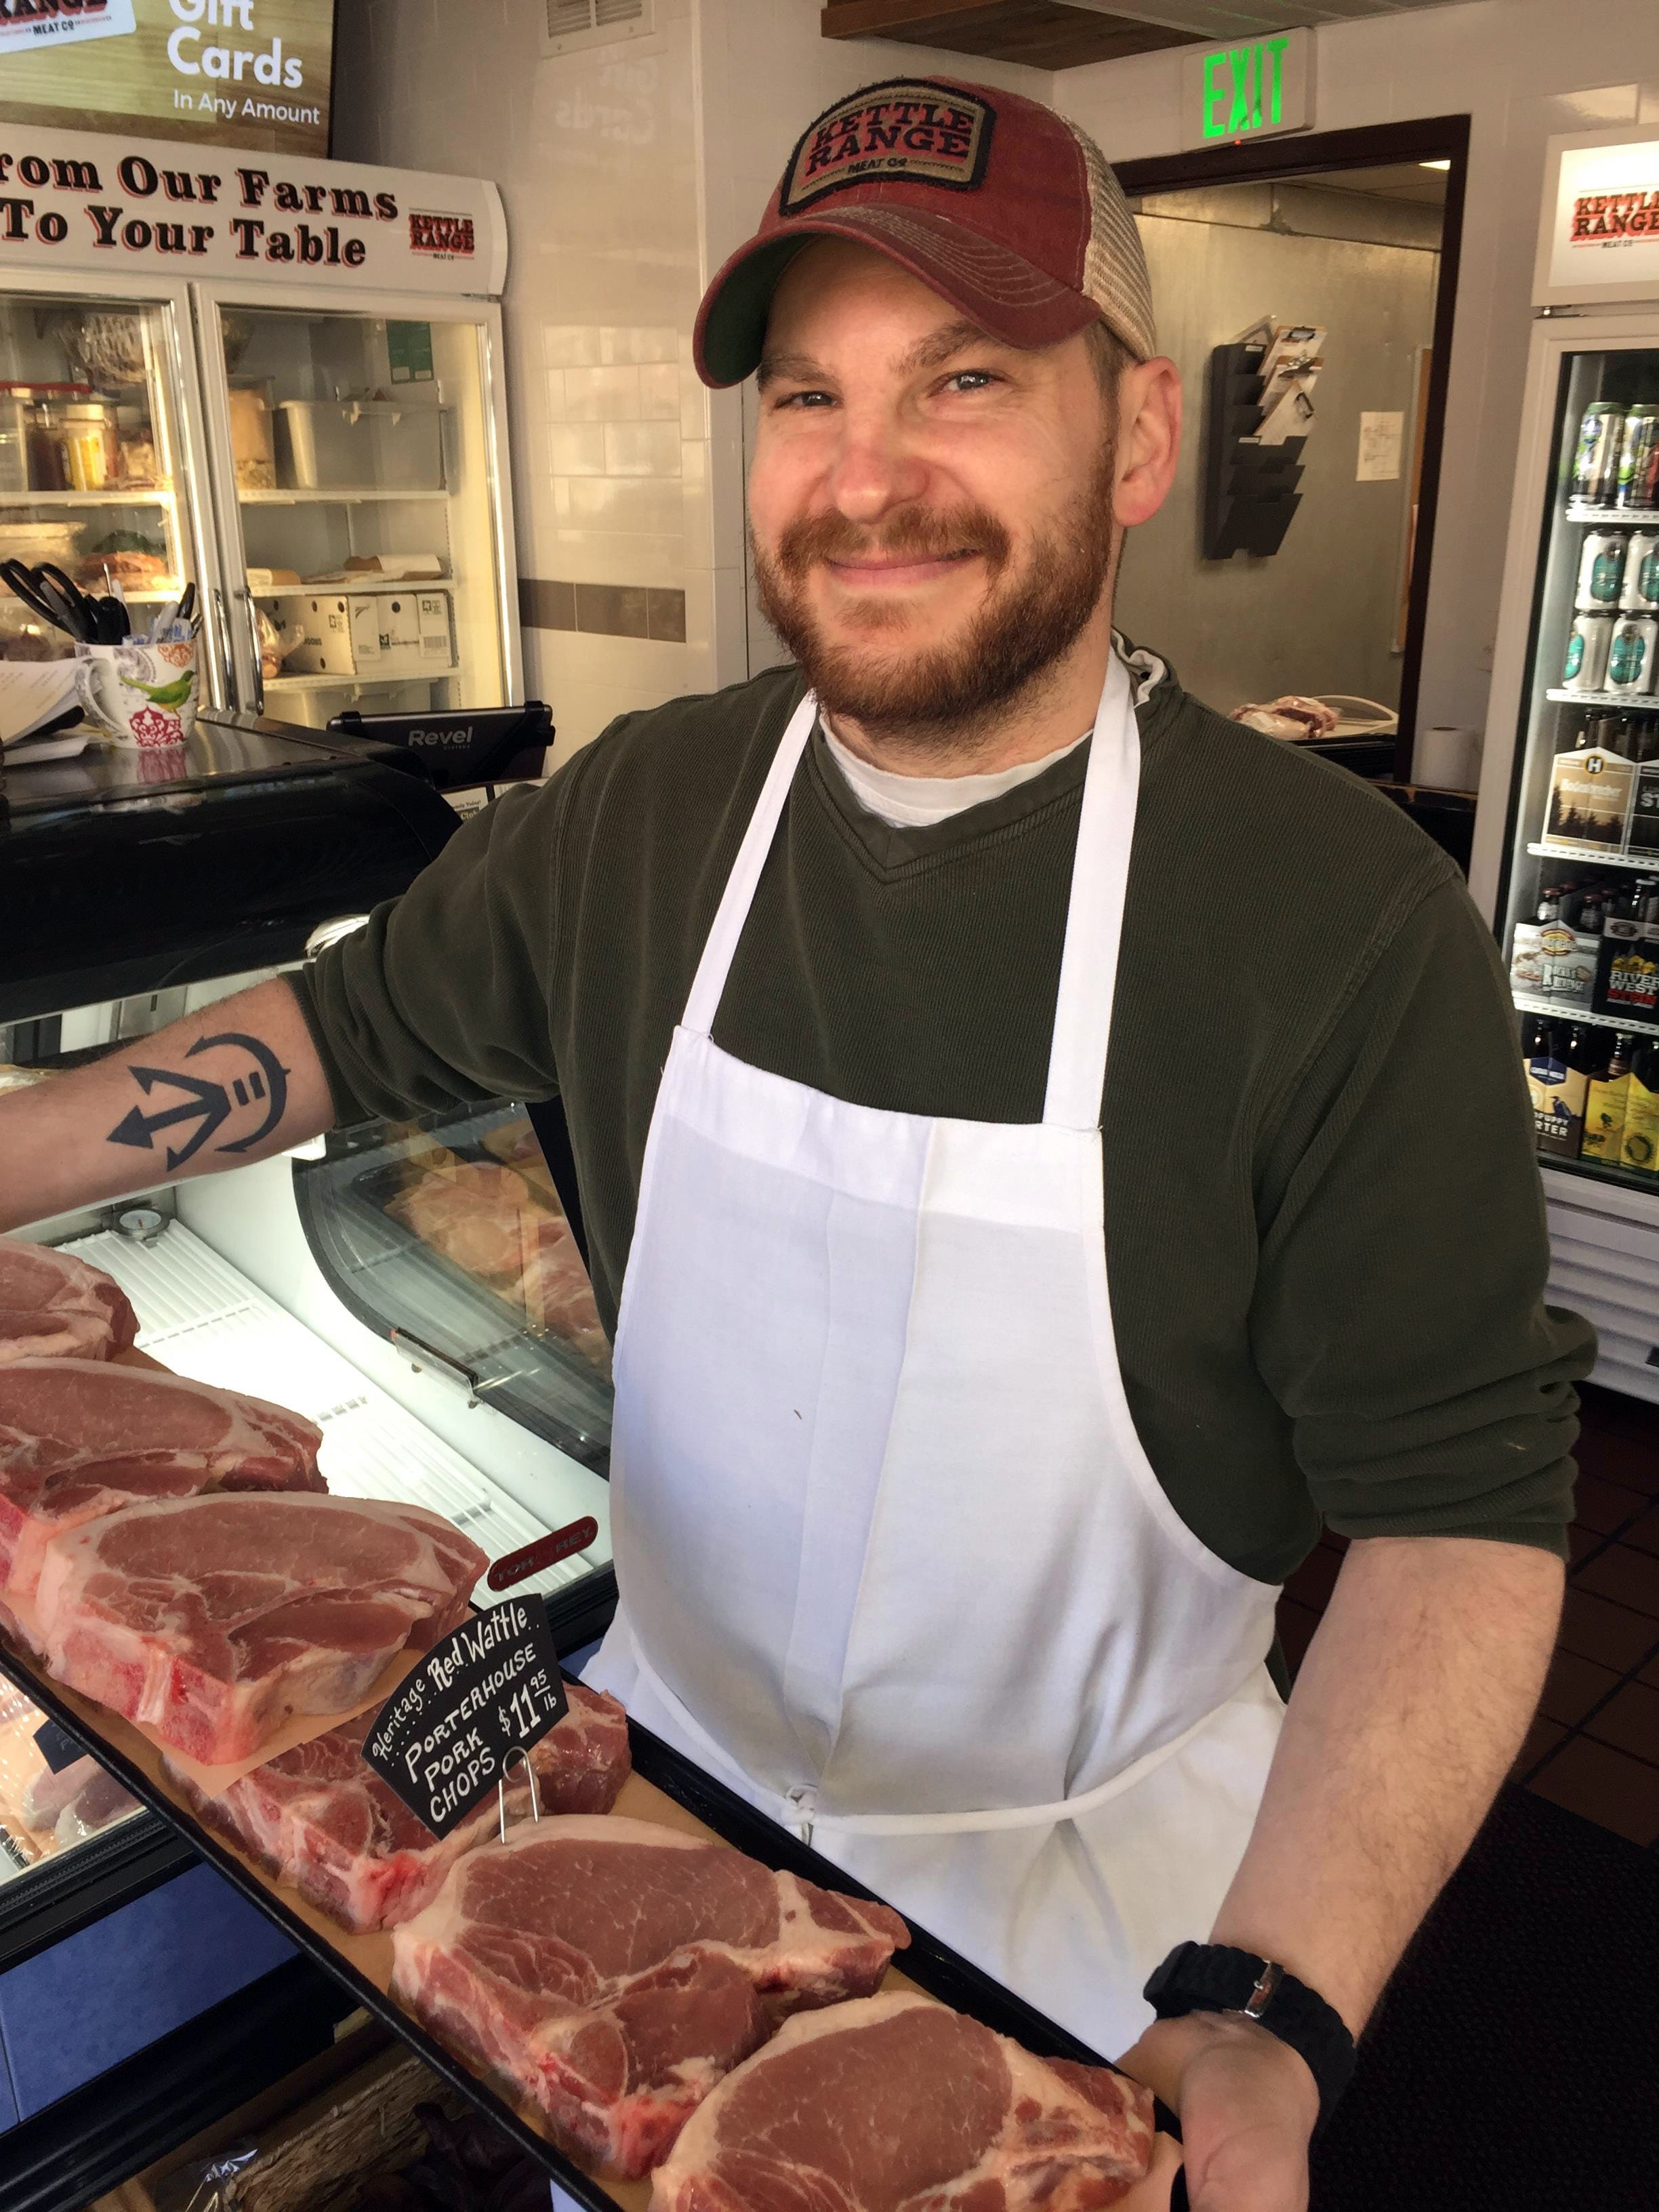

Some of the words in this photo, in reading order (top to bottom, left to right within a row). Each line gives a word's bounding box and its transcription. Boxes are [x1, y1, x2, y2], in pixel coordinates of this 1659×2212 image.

[33, 21, 60, 35] MEAT
[167, 26, 303, 88] Cards
[173, 89, 192, 109] In
[199, 92, 237, 119] Any
[241, 98, 320, 125] Amount
[1204, 37, 1290, 139] EXIT
[811, 102, 975, 151] KETTLE
[804, 125, 972, 178] RANGE
[847, 158, 882, 173] MEAT
[117, 156, 222, 204] Our
[234, 167, 398, 222] Farms
[0, 197, 68, 245] To
[84, 205, 214, 255] Your
[229, 218, 366, 268] Table
[409, 213, 473, 233] KETTLE
[409, 228, 474, 253] RANGE
[1570, 211, 1659, 241] RANGE
[408, 726, 473, 746] Revel
[1588, 758, 1603, 773] H
[1610, 980, 1658, 996] WEST
[372, 1678, 425, 1761] Heritage
[427, 1637, 464, 1692] Red
[461, 1602, 527, 1663] Wattle
[405, 1642, 536, 1784] PORTERHOUSE
[424, 1727, 483, 1793] PORK
[430, 1746, 495, 1823] CHOPS
